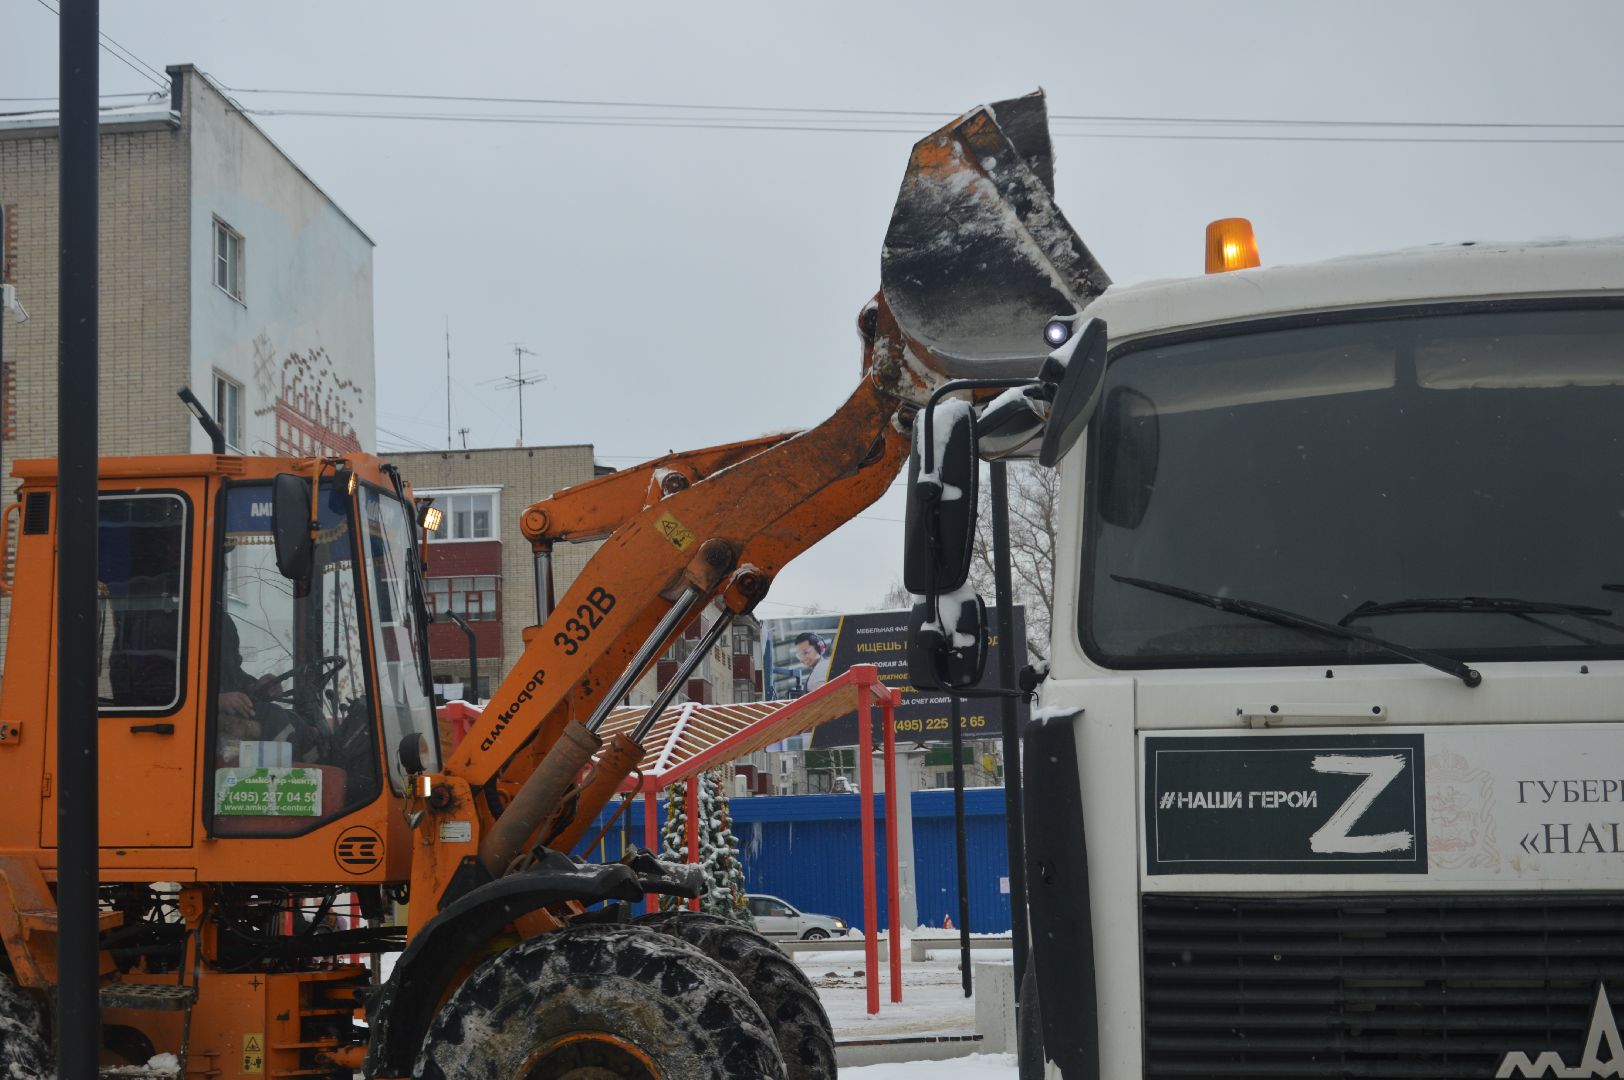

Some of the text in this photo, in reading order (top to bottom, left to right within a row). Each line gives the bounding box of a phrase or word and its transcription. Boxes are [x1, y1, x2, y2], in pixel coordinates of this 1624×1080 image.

[856, 626, 894, 634] МЕБЕЛЬНАЯ
[856, 641, 902, 653] ИЩЕШЬ
[897, 660, 909, 668] ЗА
[910, 697, 928, 705] СЧЕТ
[480, 668, 546, 752] амкодор
[894, 719, 922, 733] (495)
[926, 718, 949, 730] 225
[969, 716, 985, 728] 65
[229, 791, 259, 804] (495)
[287, 791, 301, 802] 04
[304, 791, 318, 802] 50
[1159, 790, 1318, 809] #НАШИ ГЕРОИ
[1310, 753, 1416, 854] Z
